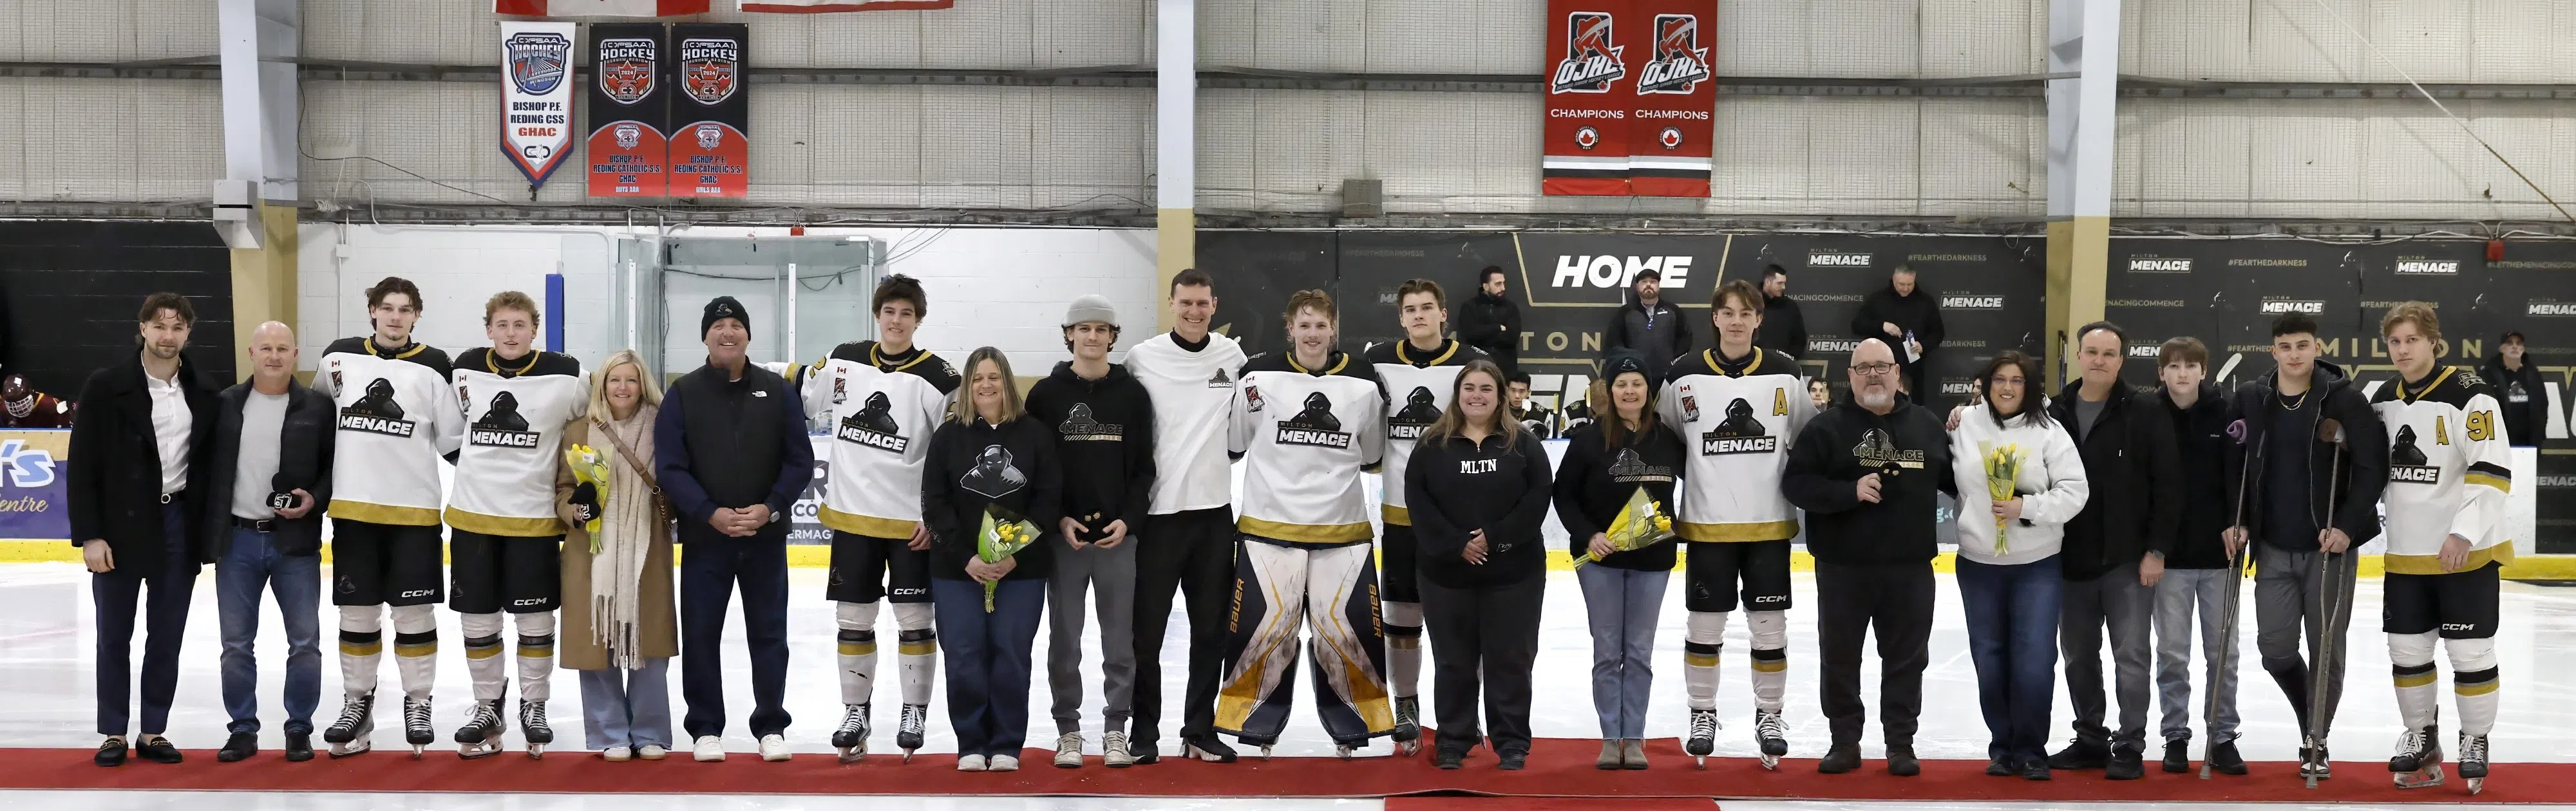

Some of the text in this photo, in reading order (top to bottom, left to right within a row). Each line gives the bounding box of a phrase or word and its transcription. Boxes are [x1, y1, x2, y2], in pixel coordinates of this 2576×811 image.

[514, 44, 562, 62] HOCKEY
[600, 48, 655, 61] HOCKEY
[683, 48, 737, 61] HOCKEY
[1557, 55, 1620, 85] OJHL
[1642, 57, 1703, 86] OJHL
[513, 102, 562, 111] BISHOP P.F.
[1551, 109, 1624, 118] CHAMPIONS
[1636, 109, 1709, 120] CHAMPIONS
[511, 115, 564, 124] REDING CSS
[518, 127, 556, 136] GHAC
[690, 155, 713, 163] BISHOP
[674, 165, 697, 173] REDING
[699, 165, 729, 173] CATHOLIC
[619, 174, 636, 183] GHAC
[700, 175, 717, 183] GHAC
[1810, 255, 1870, 265] MENACE
[2130, 261, 2191, 271] MENACE
[2397, 262, 2458, 272] MENACE
[1551, 256, 1692, 288] HOME
[1942, 297, 2003, 308] MENACE
[2262, 303, 2324, 313] MENACE
[2528, 304, 2576, 315] MENAC
[1809, 342, 1859, 352] MENAC
[2129, 346, 2161, 357] MEN
[2319, 338, 2482, 359] MILON
[1941, 383, 1974, 394] MEN
[1772, 387, 1788, 416] A
[340, 415, 413, 436] MENACE
[1064, 424, 1124, 434] MENACE
[2436, 415, 2450, 445] A
[2465, 410, 2496, 442] 91
[1390, 425, 1430, 438] MEN
[471, 431, 538, 446] MENACE
[840, 425, 907, 451] MENACE
[1278, 429, 1349, 447] MENACE
[1705, 438, 1775, 453] MENACE
[1859, 447, 1924, 461] MENACE
[1460, 458, 1497, 474] MLTN
[2391, 467, 2438, 481] ENACE
[2536, 476, 2576, 486] ENAC
[0, 495, 49, 512] entre
[787, 529, 832, 539] ERMAG
[401, 588, 435, 598] CCM
[894, 587, 926, 595] CCM
[514, 597, 547, 606] CCM
[1755, 595, 1786, 603] CCM
